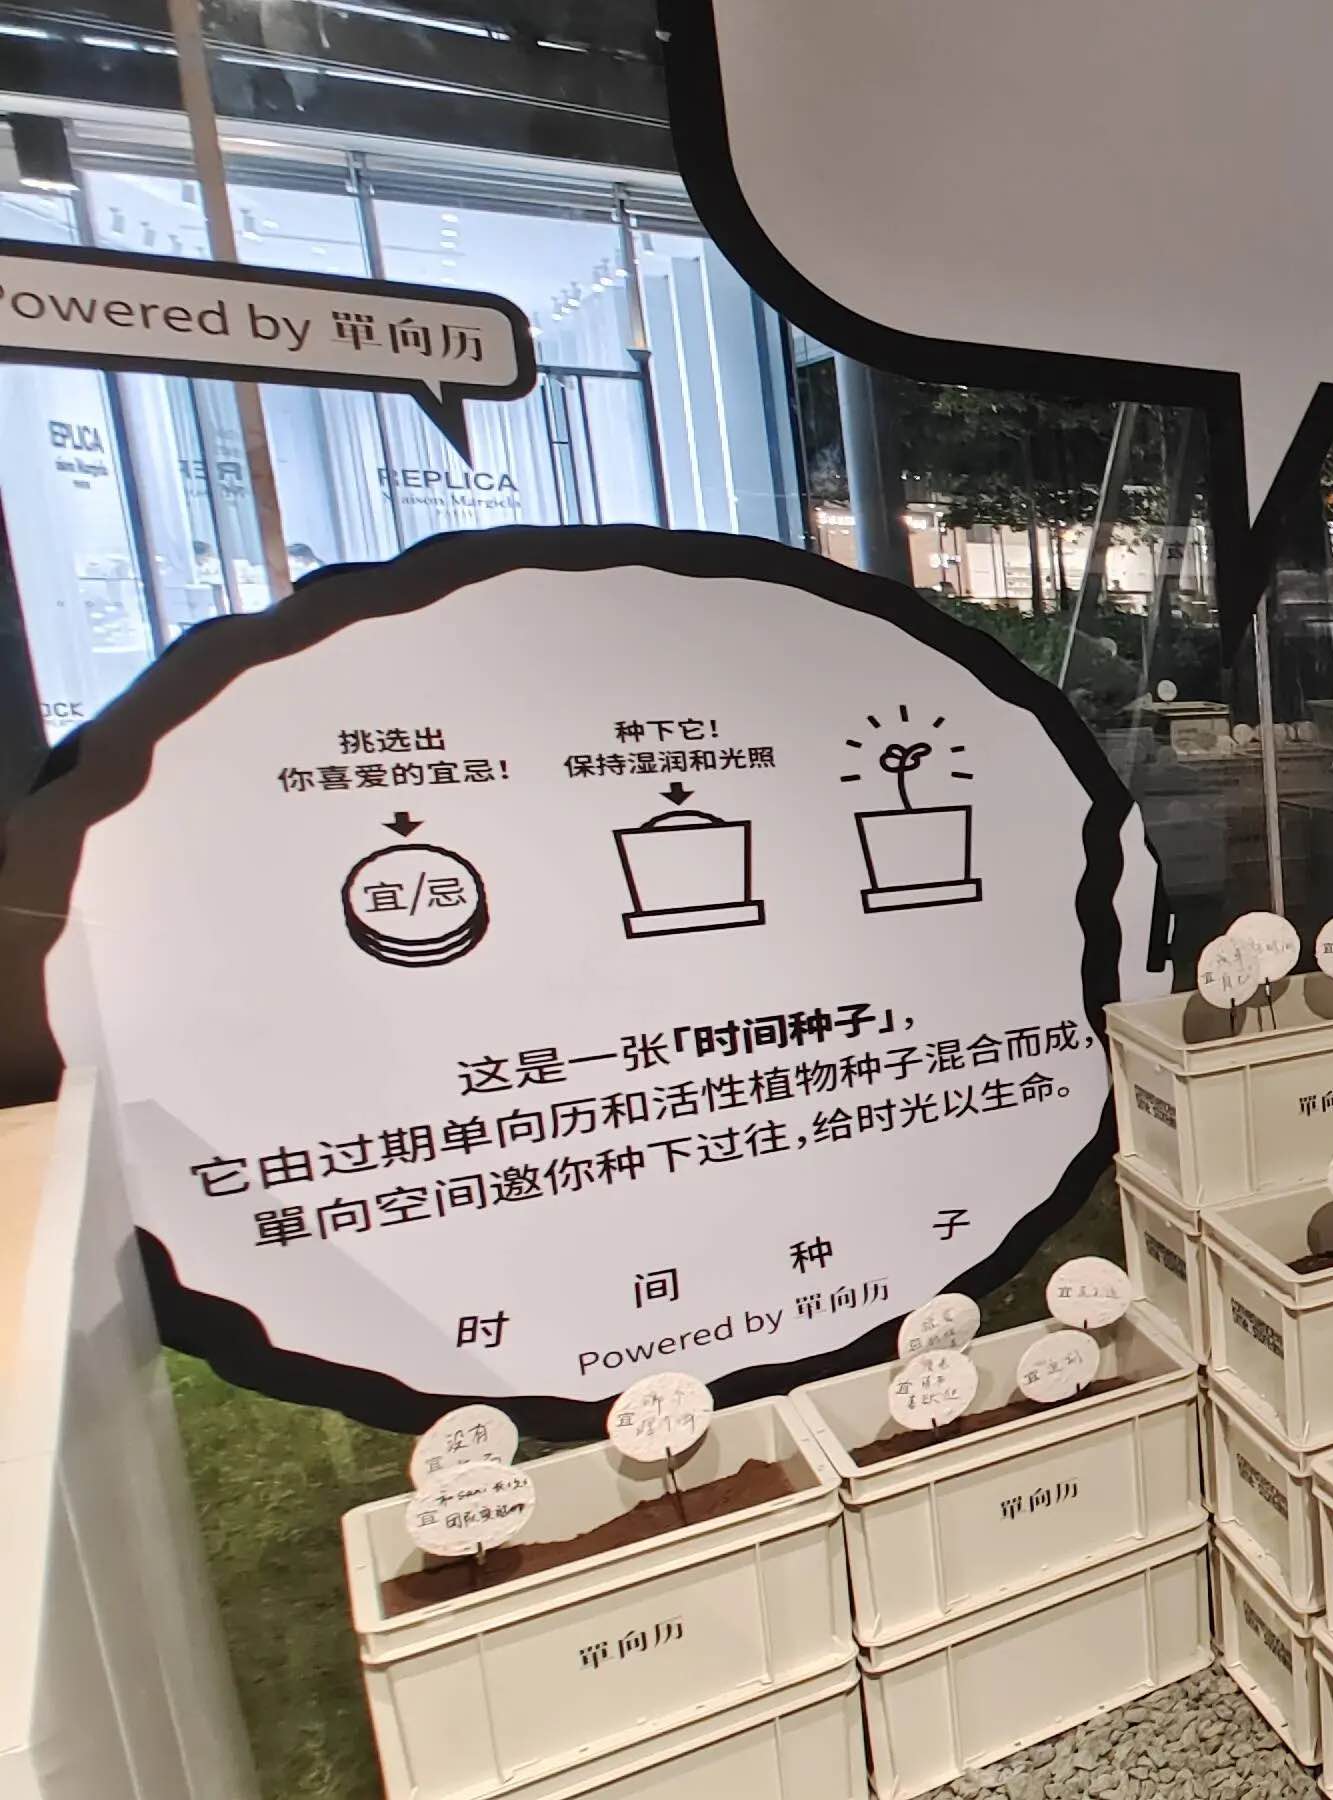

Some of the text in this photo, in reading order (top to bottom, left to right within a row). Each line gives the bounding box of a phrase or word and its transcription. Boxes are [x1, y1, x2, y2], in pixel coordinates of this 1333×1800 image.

[0, 284, 484, 362] owered by 單向历
[338, 727, 446, 755] 挑选出
[614, 718, 720, 744] 种下它!
[277, 758, 511, 793] 你喜爱的宜忌!
[563, 746, 776, 779] 保持湿润和光照
[363, 871, 468, 917] 宜/忌
[456, 1209, 970, 1349] 时 间 种 子
[578, 1277, 889, 1376] Powered by 單向历
